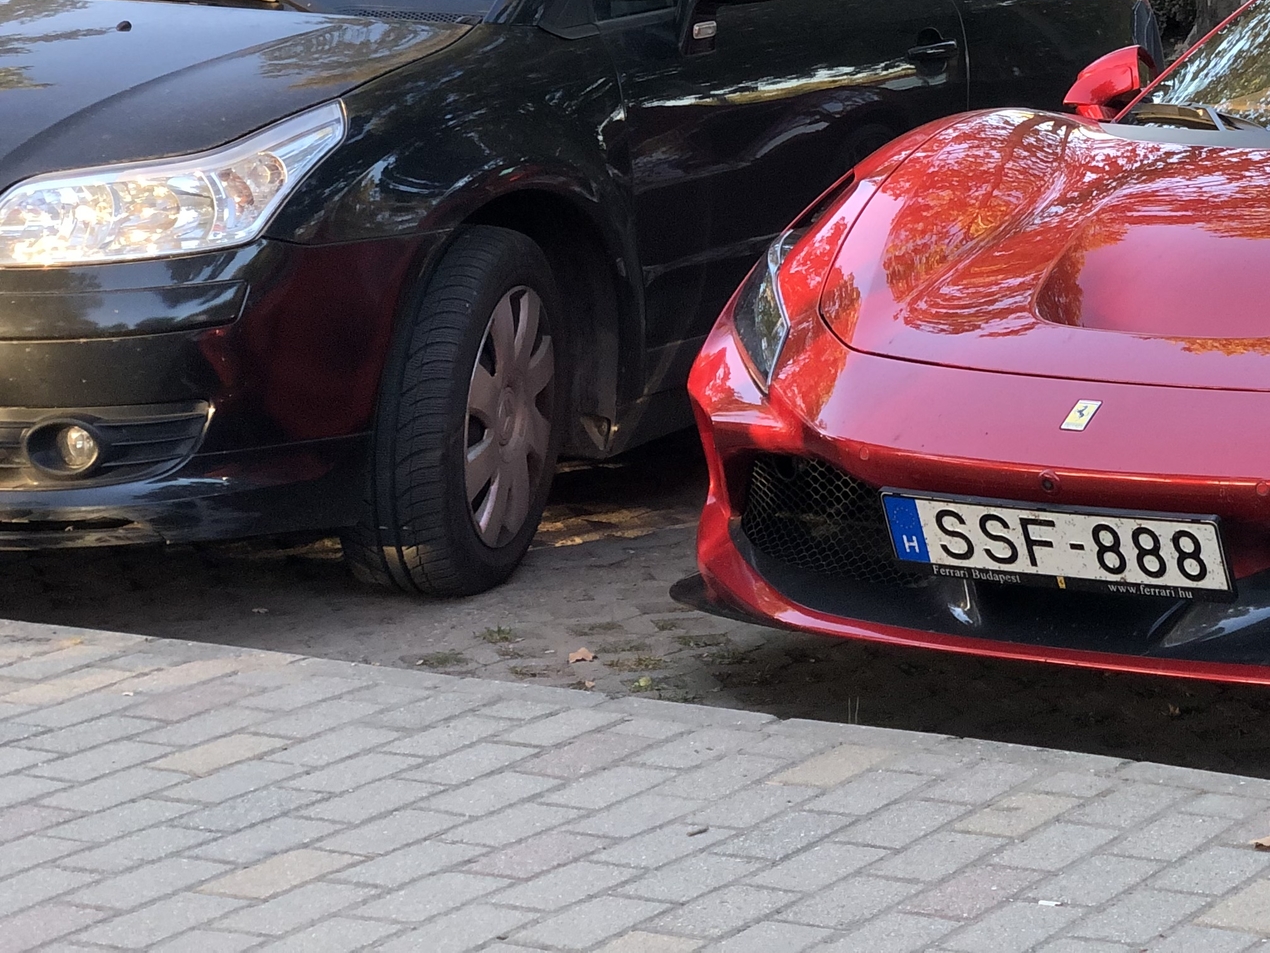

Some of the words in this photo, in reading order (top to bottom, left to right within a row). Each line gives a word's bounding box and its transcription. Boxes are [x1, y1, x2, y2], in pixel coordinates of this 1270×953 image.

[903, 534, 919, 553] H
[935, 508, 1207, 582] SSF-888
[932, 565, 969, 578] Ferrari
[971, 568, 1021, 584] Budapest
[1107, 584, 1193, 599] www.ferrari.hu
